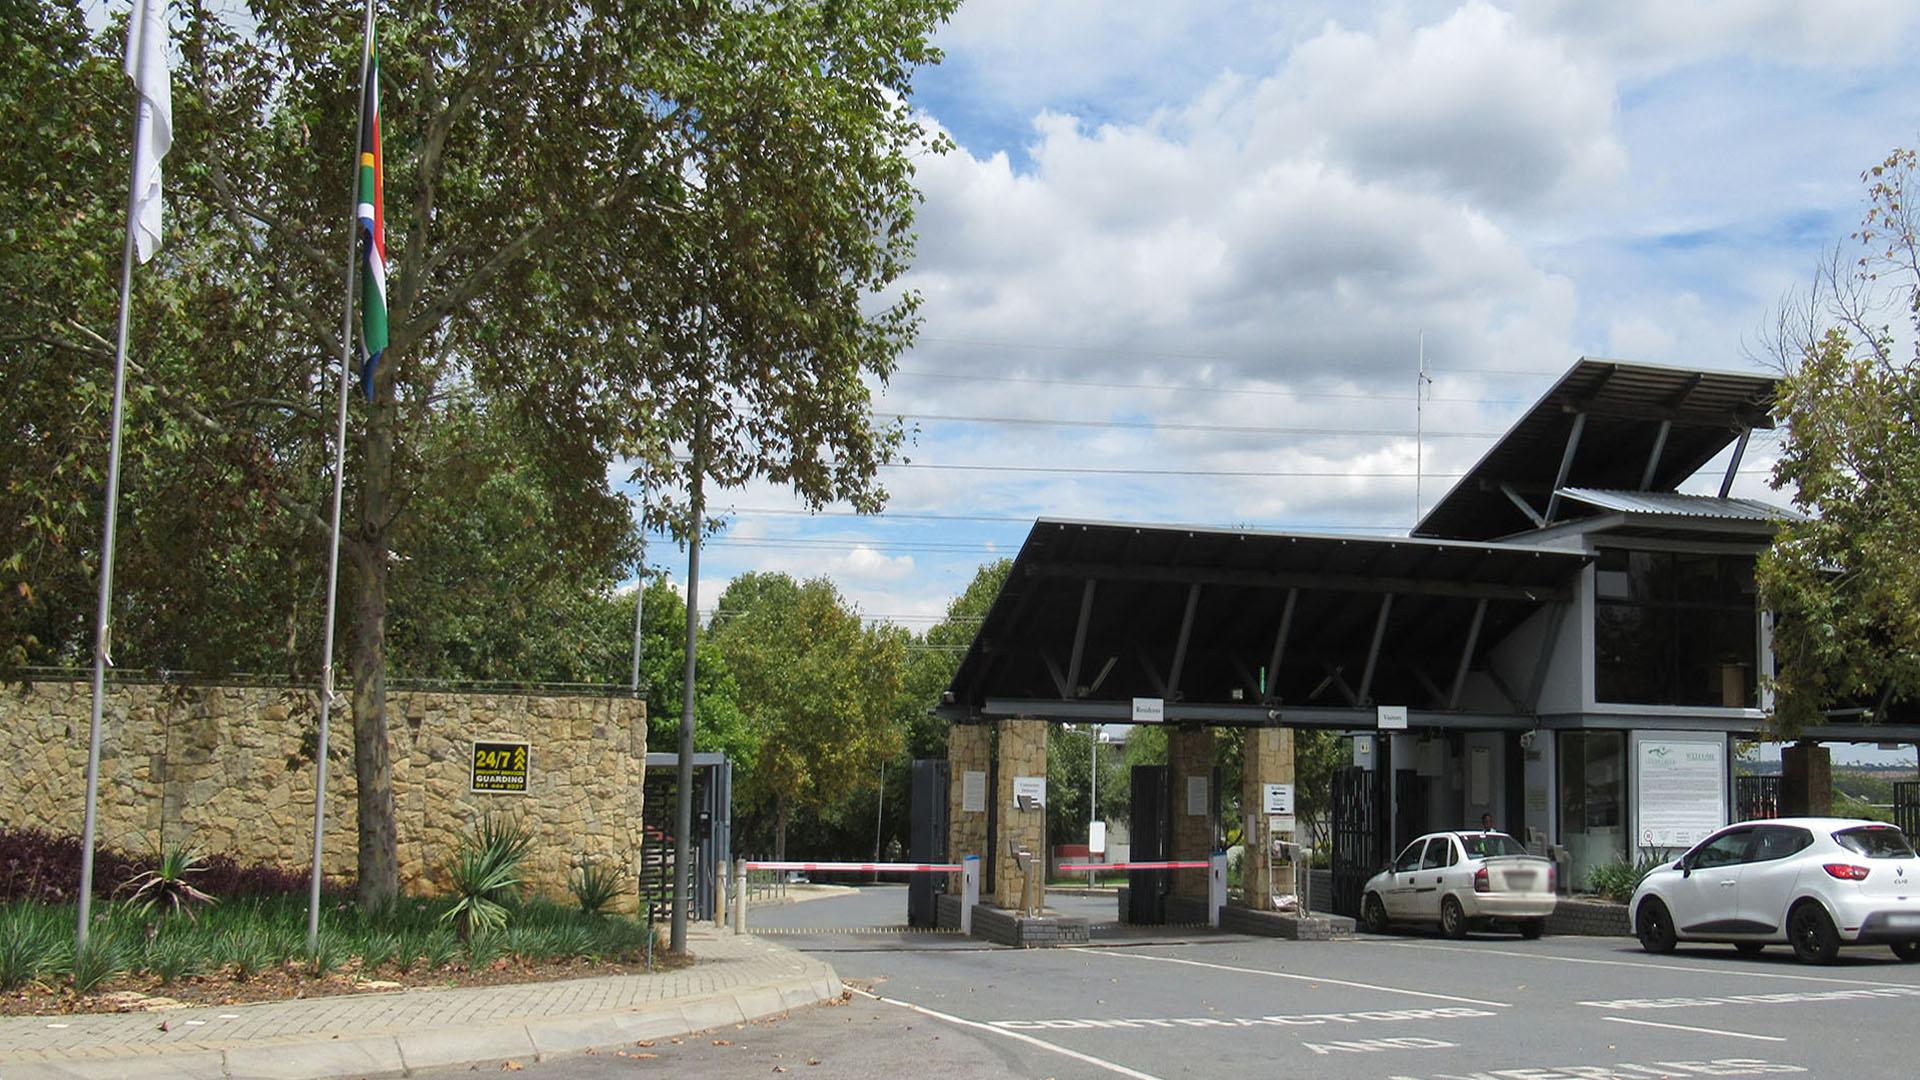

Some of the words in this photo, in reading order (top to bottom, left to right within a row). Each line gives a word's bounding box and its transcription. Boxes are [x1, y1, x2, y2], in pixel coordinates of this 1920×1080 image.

[476, 751, 511, 769] 24/7
[476, 775, 524, 783] GUARDING
[984, 1007, 1498, 1029] CONTRACTORS
[1303, 1037, 1460, 1055] AND
